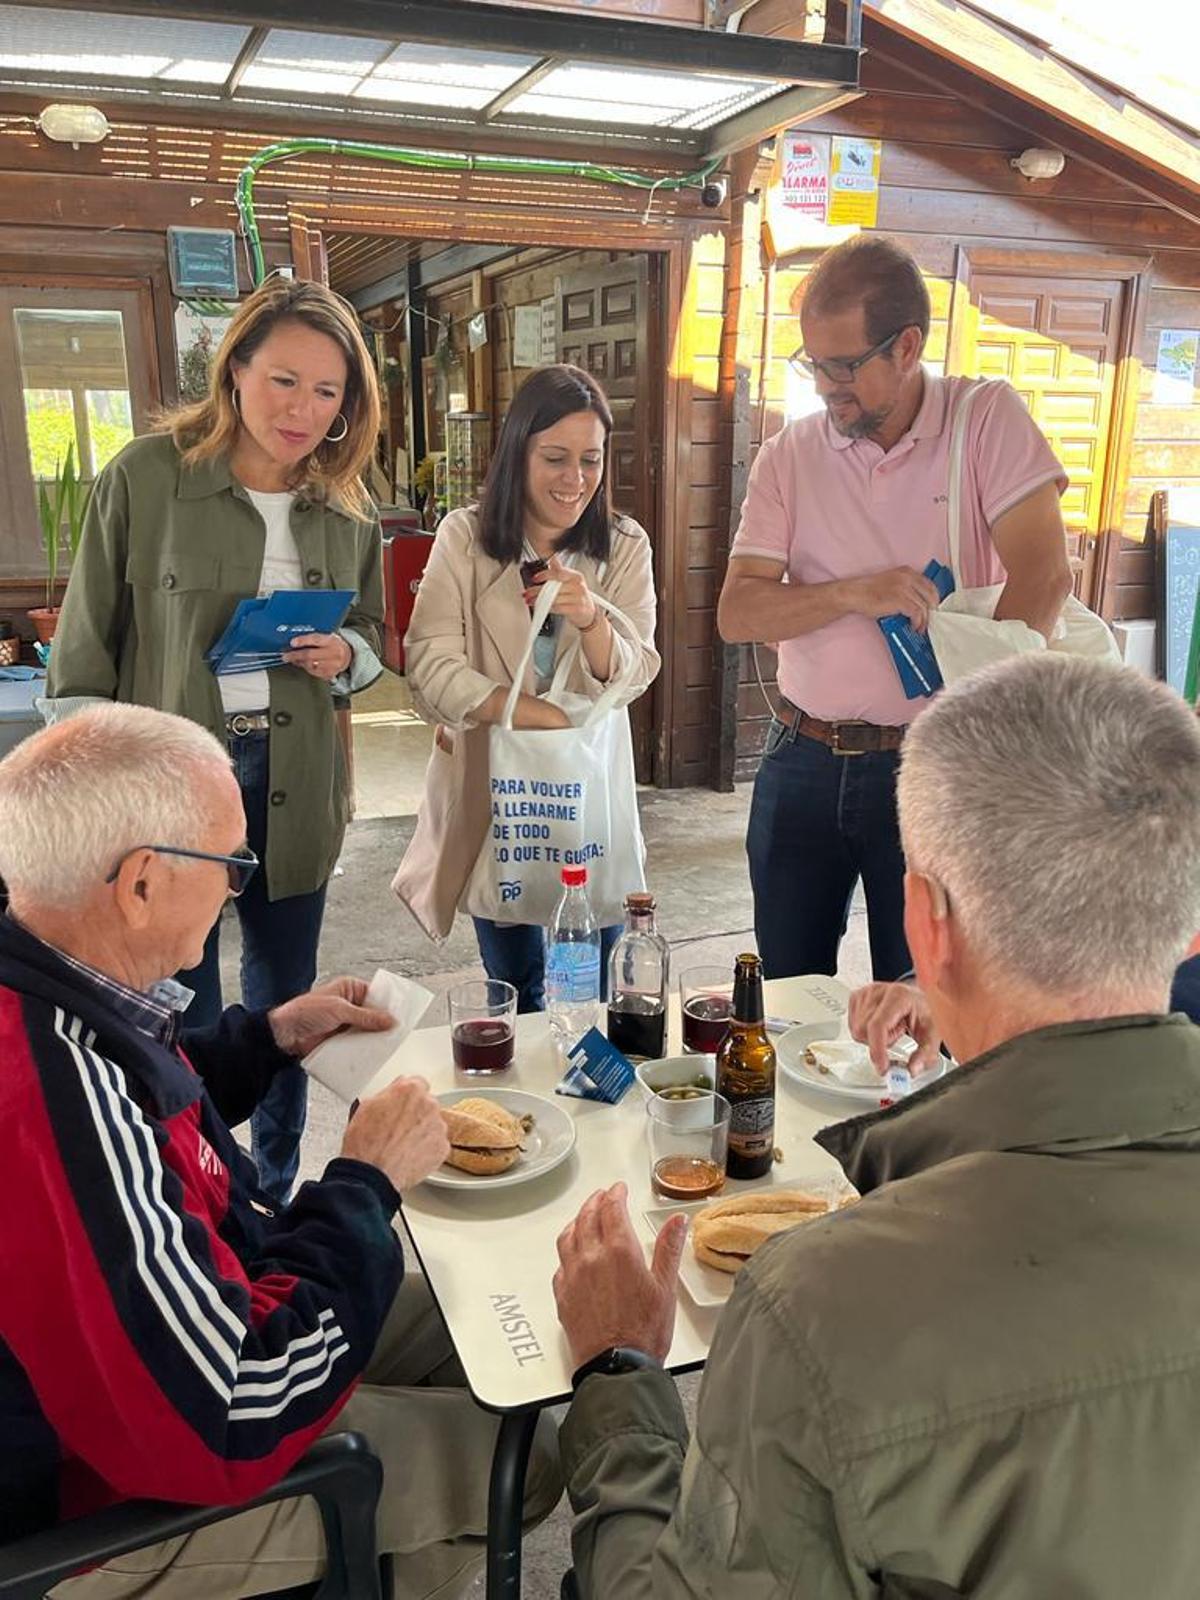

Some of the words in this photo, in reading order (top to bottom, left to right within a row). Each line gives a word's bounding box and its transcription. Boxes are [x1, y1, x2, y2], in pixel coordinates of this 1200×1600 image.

[491, 778, 526, 794] PARA
[530, 781, 582, 798] VOLVER
[493, 801, 500, 817] A
[504, 801, 577, 821] LLENARME
[493, 824, 510, 840] DE
[513, 824, 550, 840] TODO
[513, 846, 540, 862] QUE
[544, 847, 560, 863] TE
[489, 1294, 544, 1367] AMSTEL
